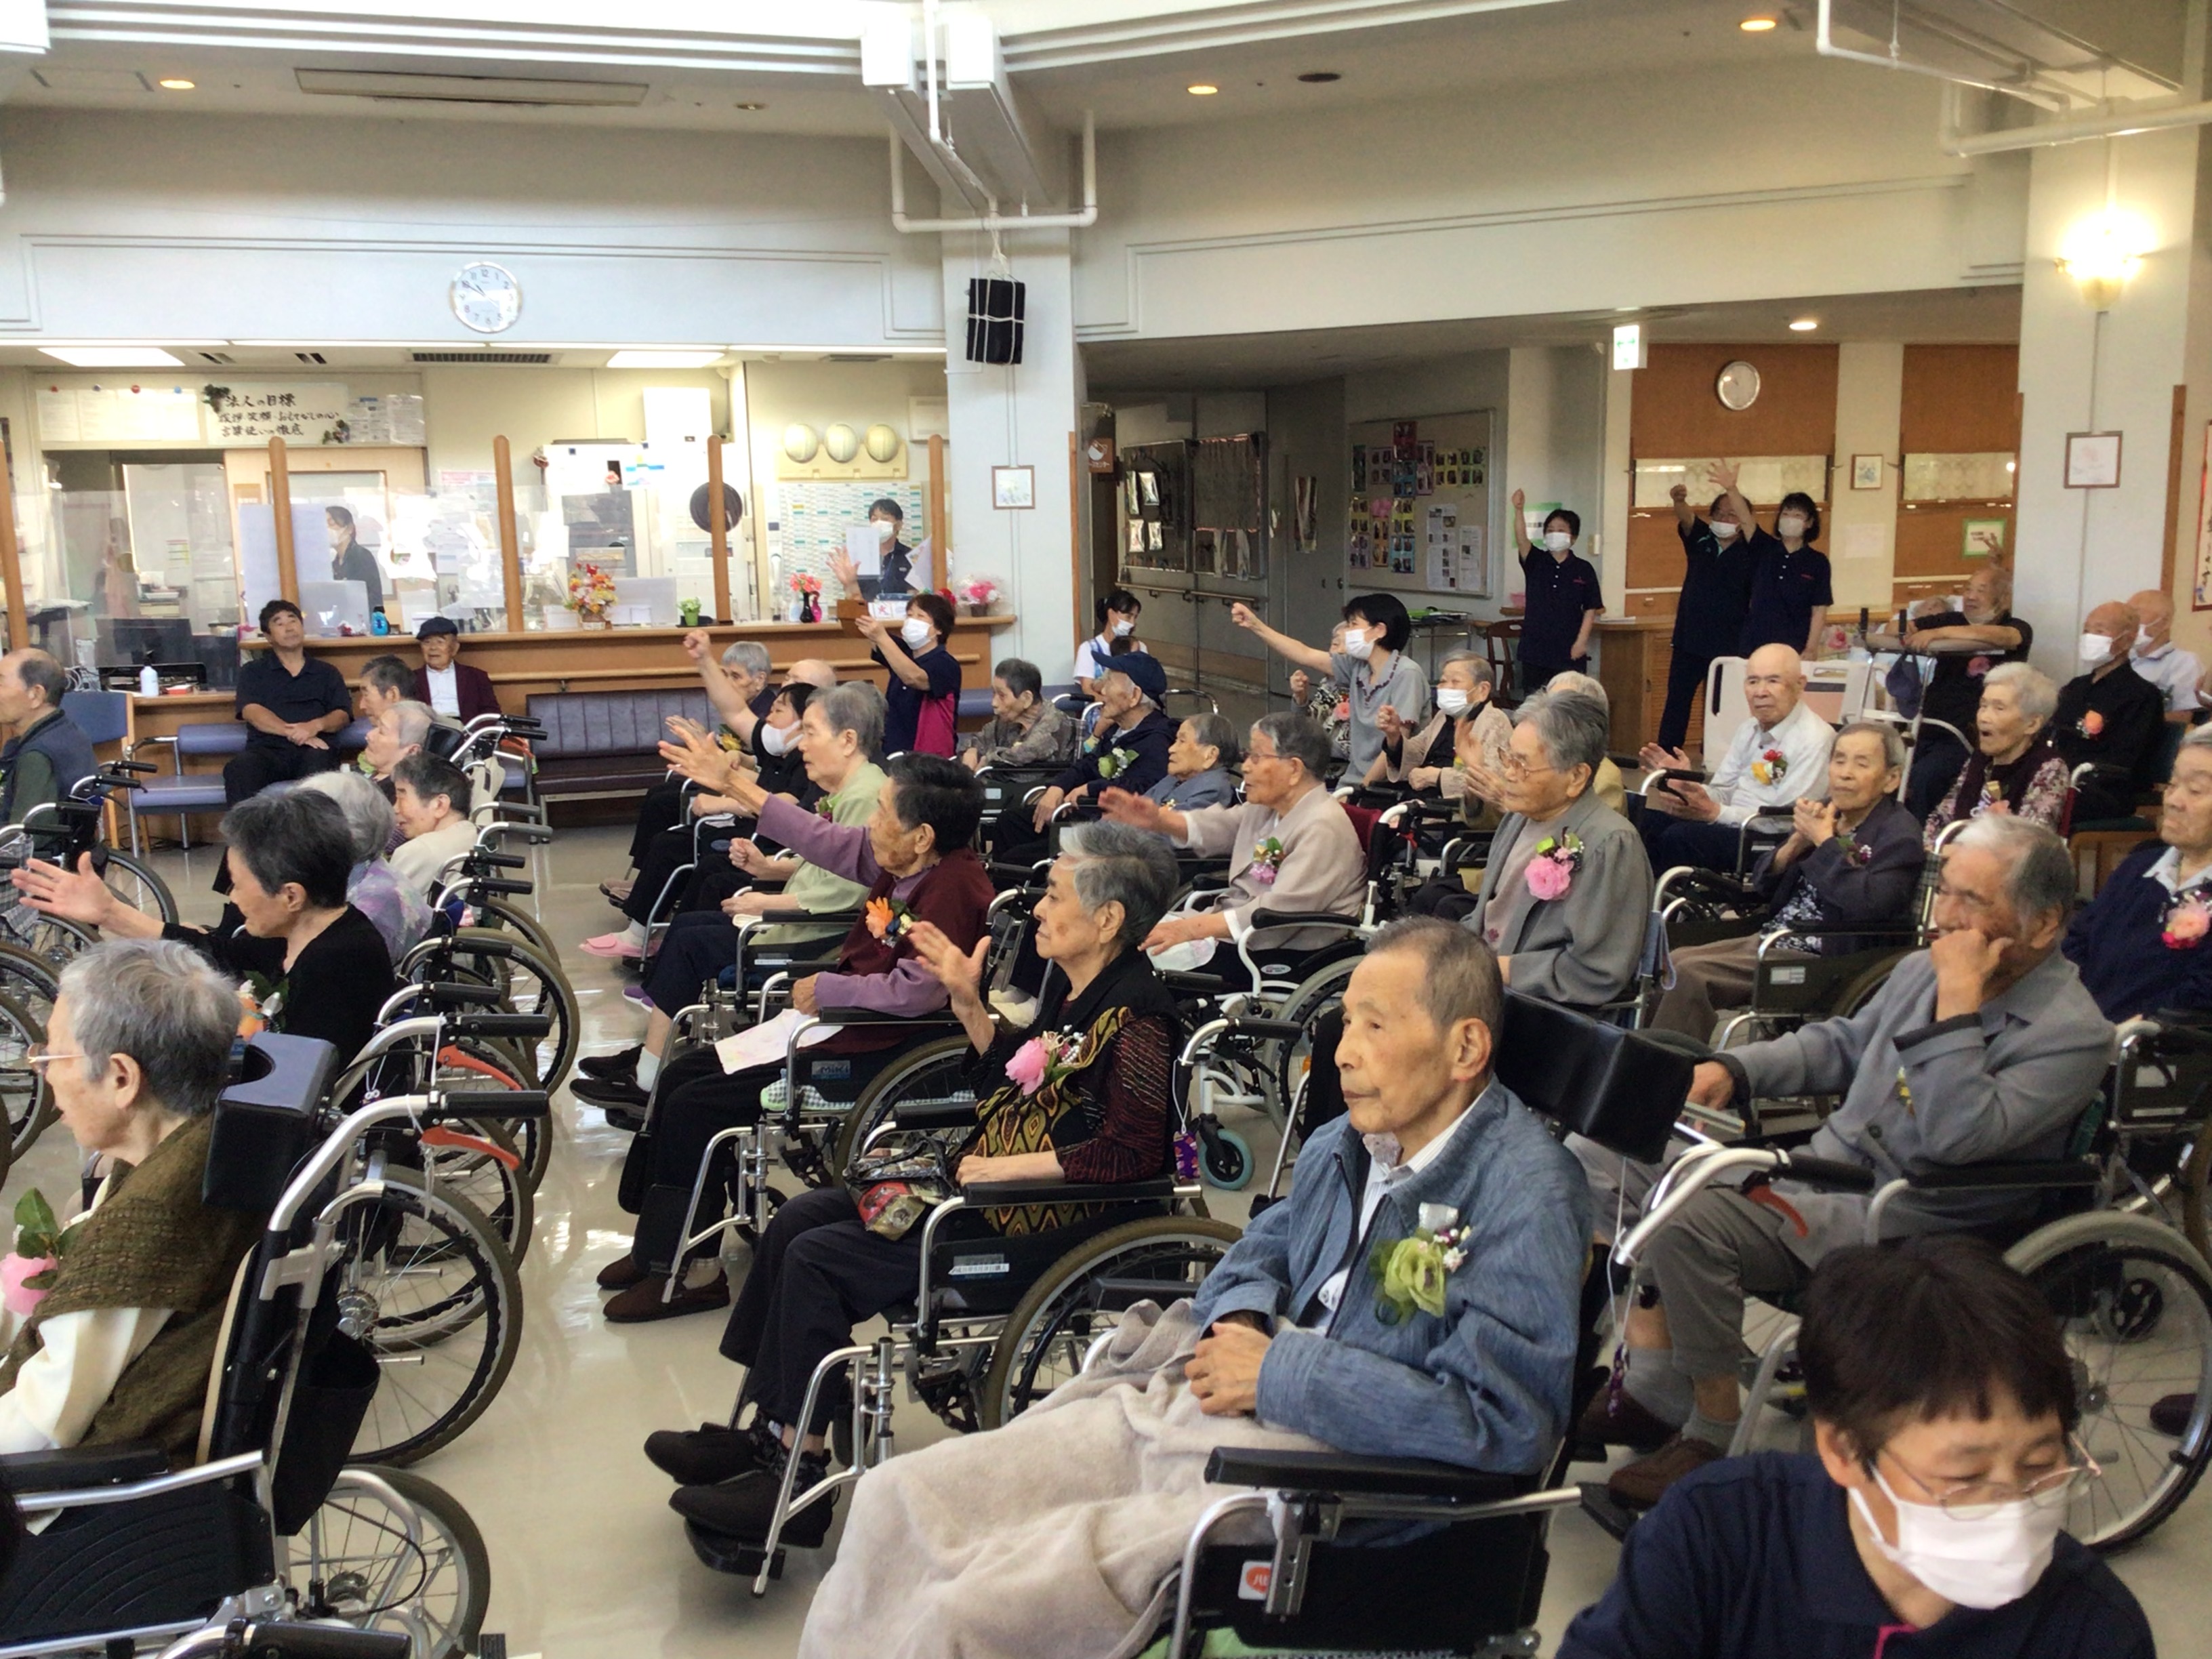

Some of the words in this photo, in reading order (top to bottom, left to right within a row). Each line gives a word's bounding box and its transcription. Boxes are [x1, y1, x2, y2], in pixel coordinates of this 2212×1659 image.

[480, 269, 489, 277] 12
[504, 281, 509, 289] 2
[464, 304, 470, 313] 8
[485, 317, 491, 325] 6
